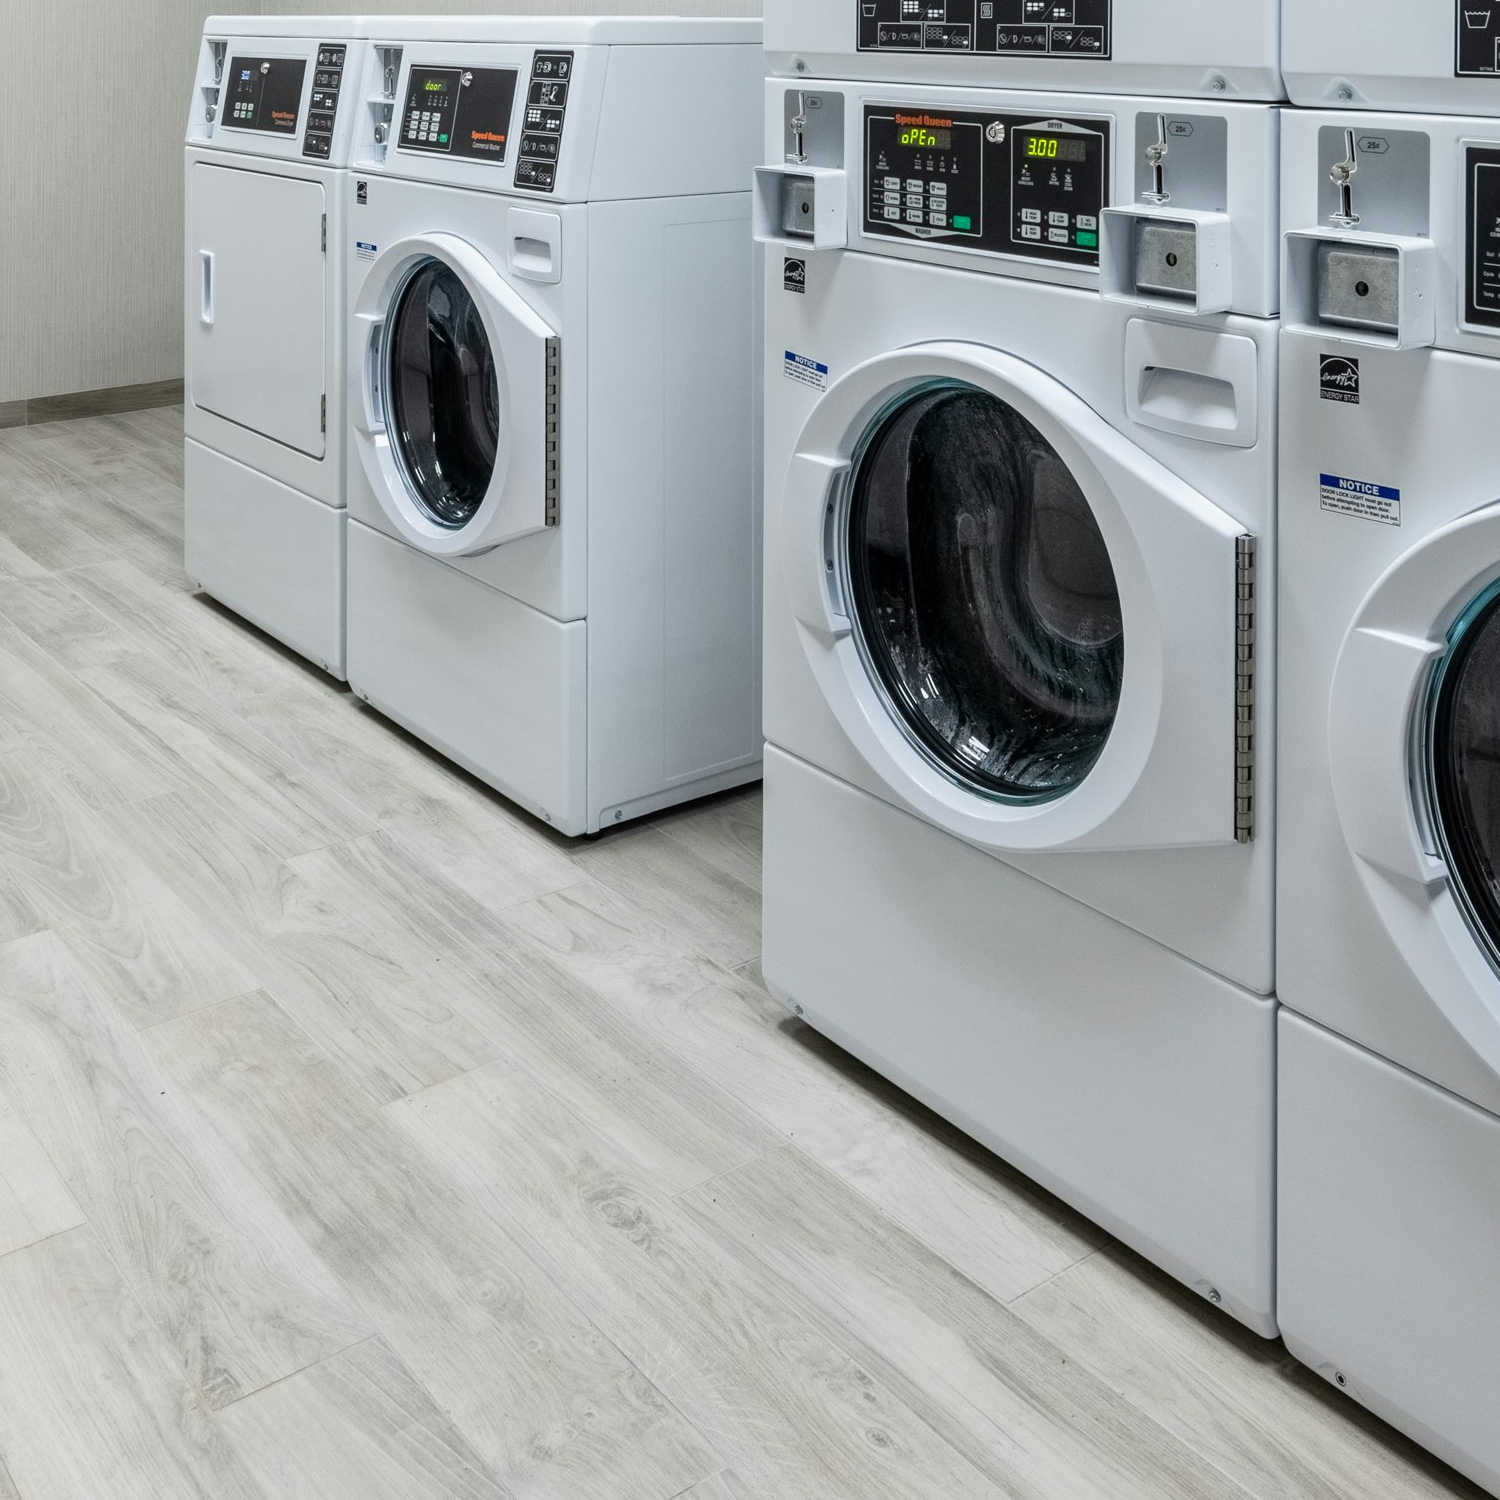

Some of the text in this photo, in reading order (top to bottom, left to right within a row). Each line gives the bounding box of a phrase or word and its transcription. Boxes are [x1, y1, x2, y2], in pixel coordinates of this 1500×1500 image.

[426, 80, 442, 90] door
[895, 113, 952, 127] Speed Queen
[471, 131, 505, 141] Speed Queen
[1028, 138, 1057, 157] 3.00
[915, 227, 932, 236] WASHER
[794, 355, 817, 370] NOTICE
[1321, 390, 1359, 403] ENERGY STAR
[1322, 487, 1336, 495] DOOR
[1350, 493, 1364, 501] LIGHT
[1339, 479, 1380, 496] NOTICE
[1336, 497, 1360, 508] attempting
